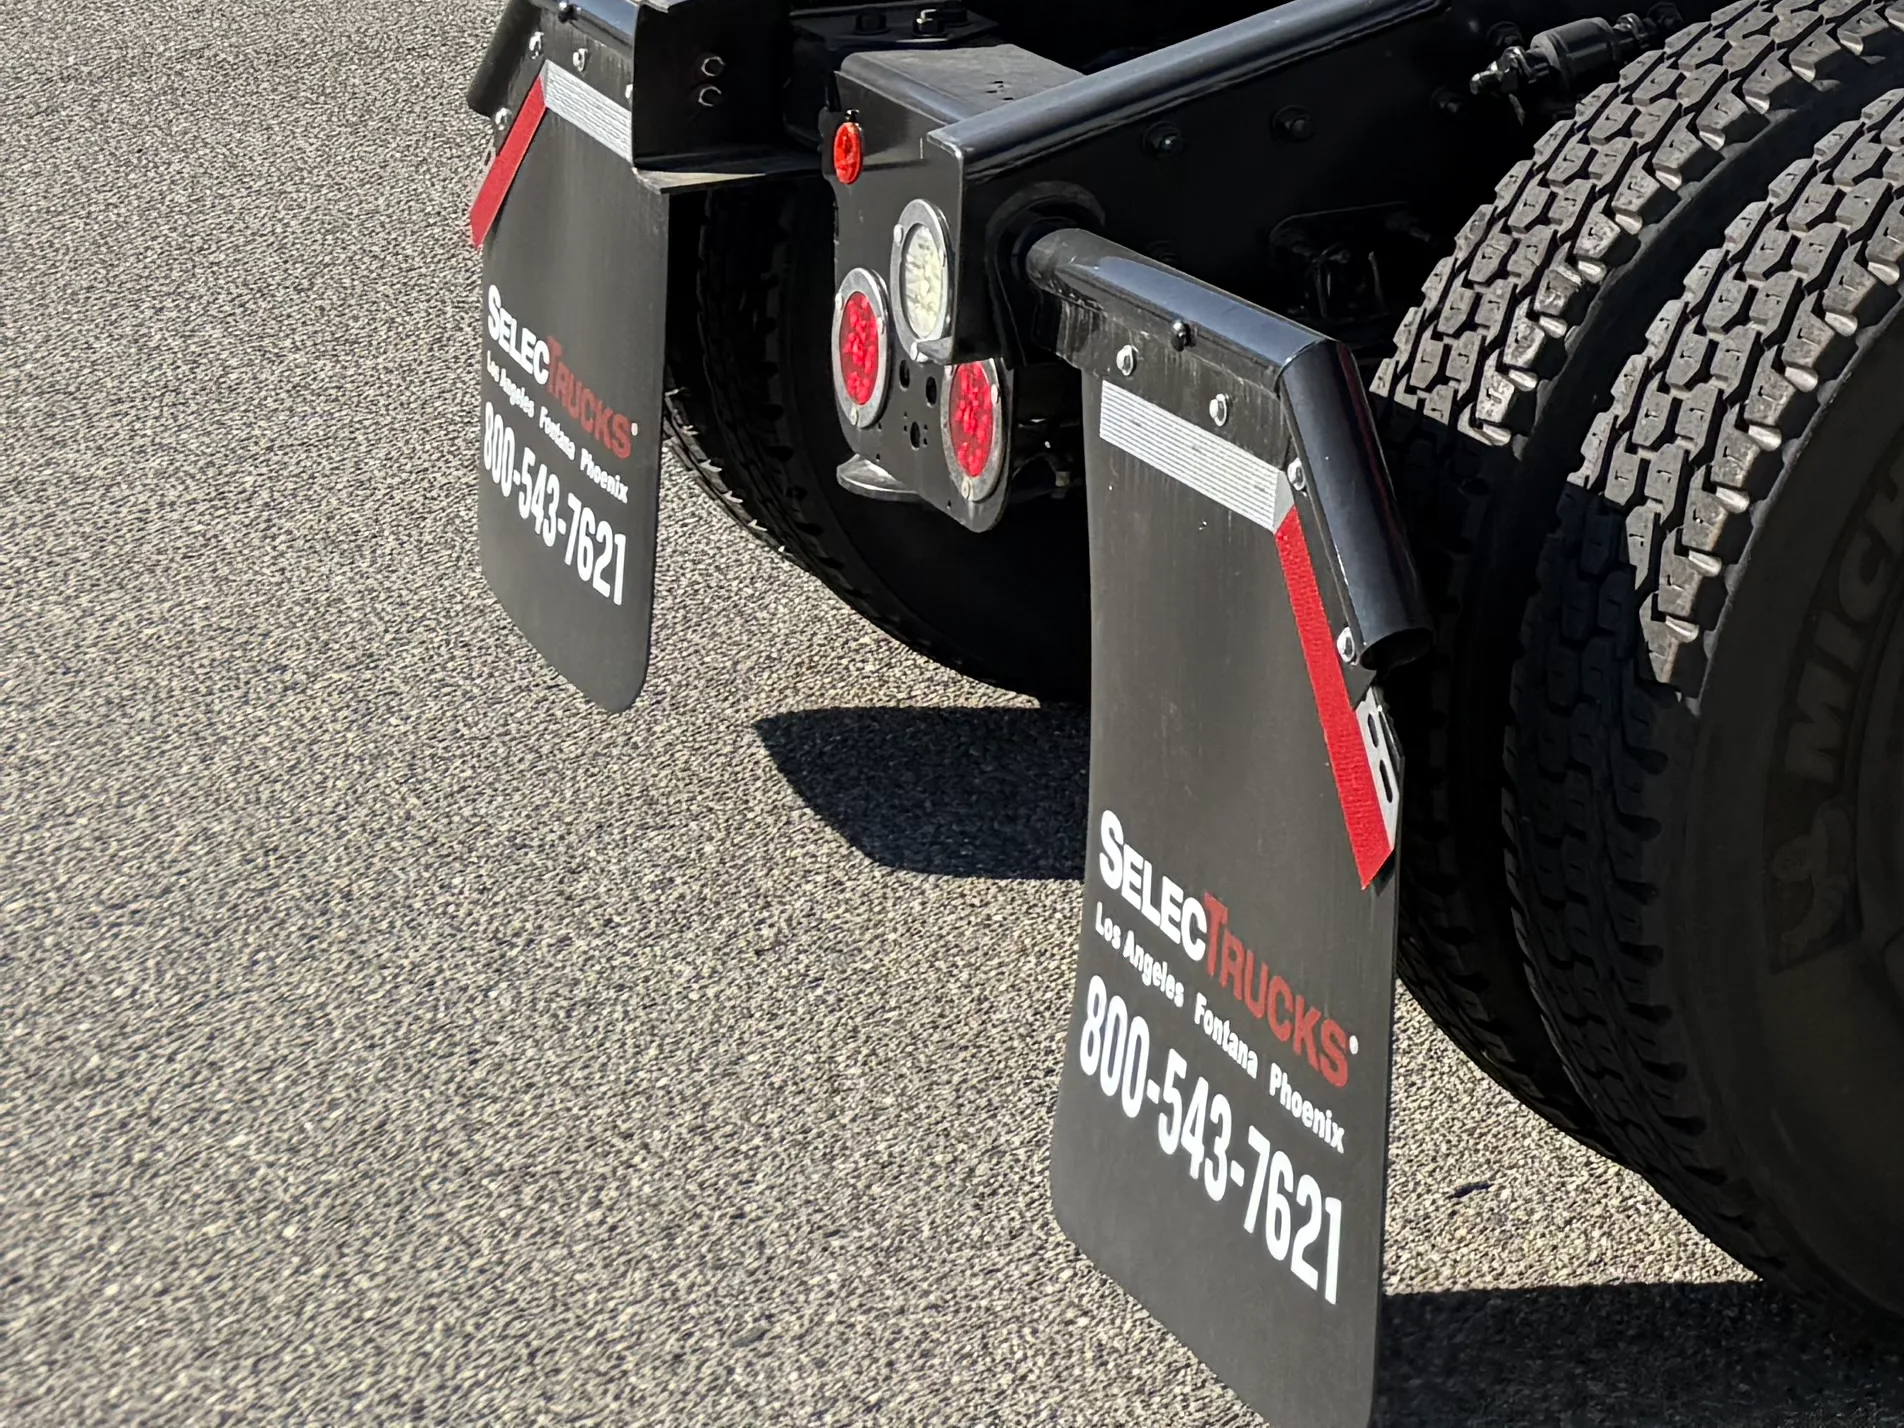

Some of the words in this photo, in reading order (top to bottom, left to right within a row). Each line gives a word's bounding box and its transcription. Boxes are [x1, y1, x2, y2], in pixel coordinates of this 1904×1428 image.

[483, 400, 627, 606] 800-543-7621
[486, 349, 500, 383] Los
[499, 368, 535, 419] Angeles
[538, 405, 576, 461] Fontana
[579, 447, 629, 505] Phoenix
[1079, 974, 1343, 1307] 800-543-7621
[1095, 901, 1121, 951] Los
[1122, 929, 1186, 1009] Angeles
[1193, 990, 1259, 1081] Fontana
[1269, 1061, 1347, 1155] Phoenix
